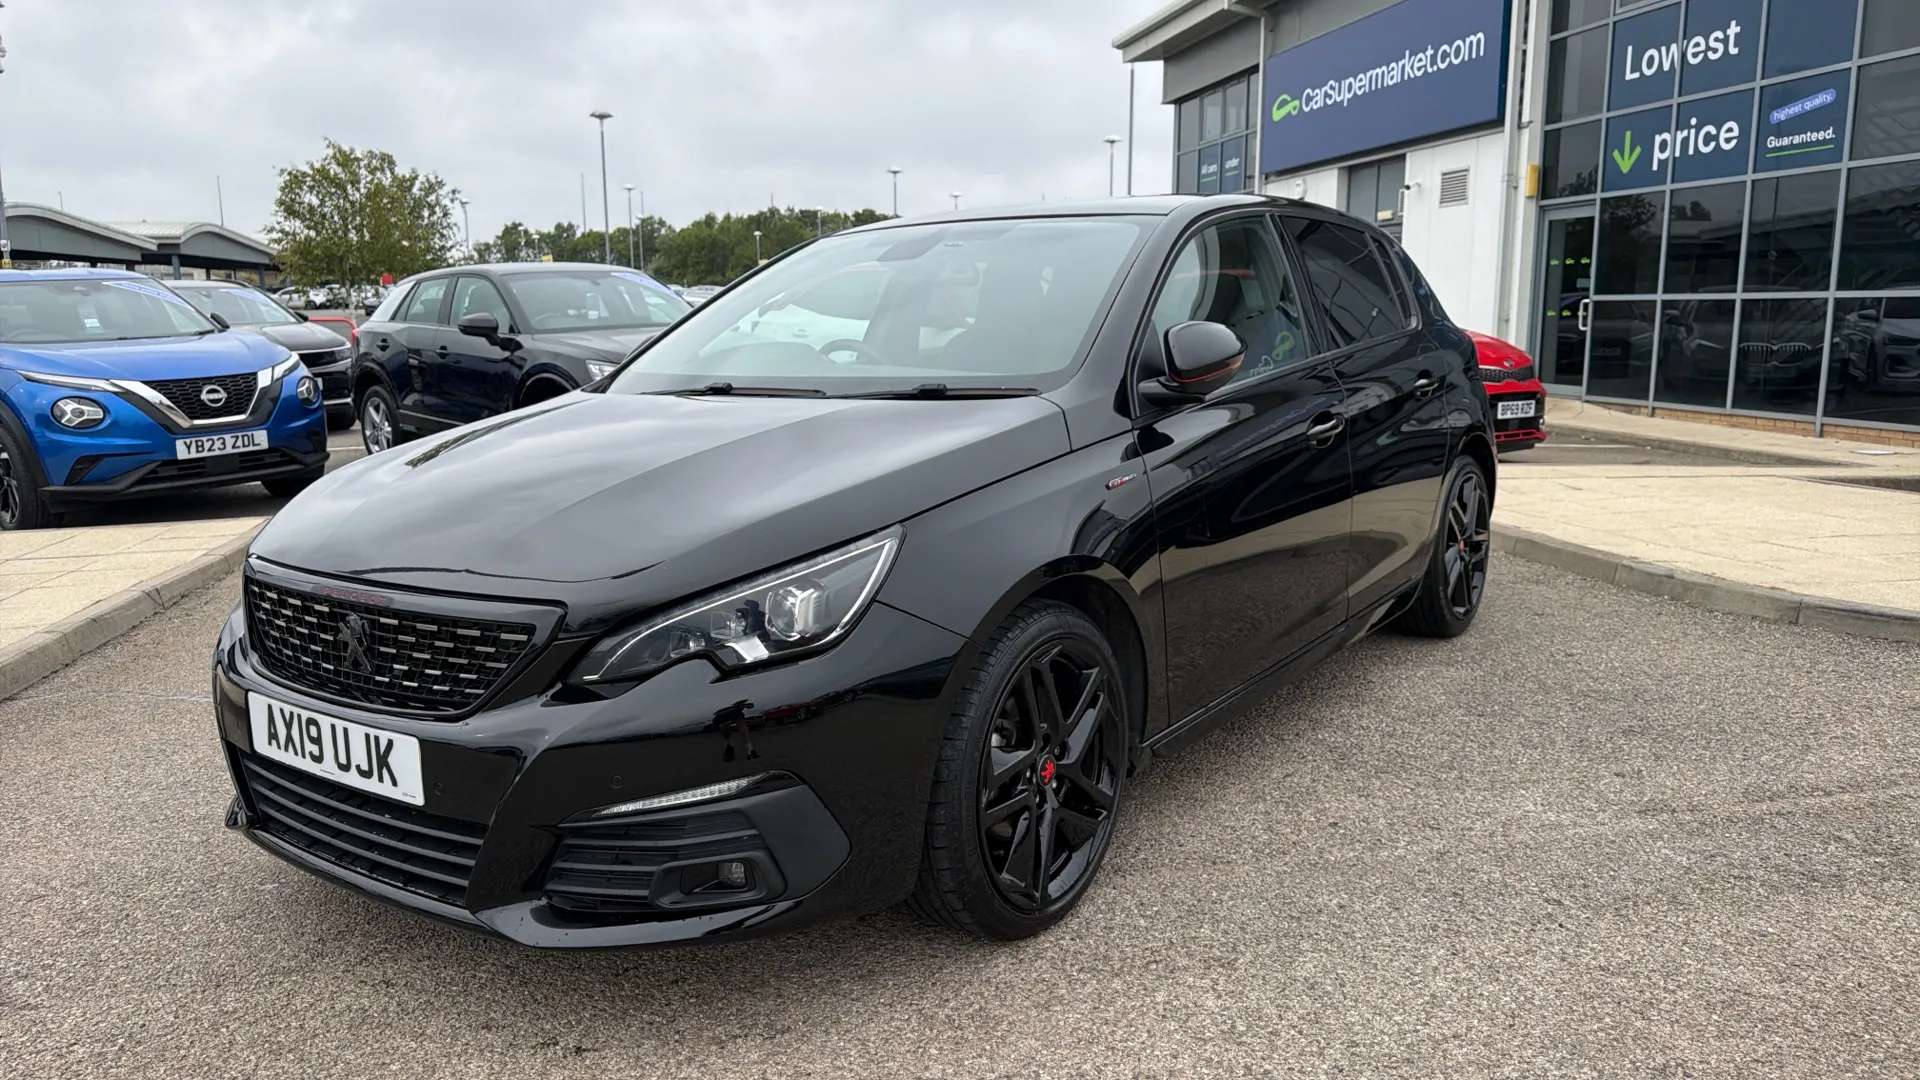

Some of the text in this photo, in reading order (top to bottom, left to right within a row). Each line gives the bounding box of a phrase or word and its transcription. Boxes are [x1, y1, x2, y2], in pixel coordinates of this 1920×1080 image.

[1301, 31, 1486, 113] CarSupermarket.com
[1624, 19, 1741, 81] Lowest
[1766, 126, 1836, 149] Guaranteed.
[1773, 103, 1802, 121] highest
[1651, 116, 1740, 171] price
[183, 433, 261, 455] YB23 ZDL
[267, 703, 398, 788] AX19 UJK
